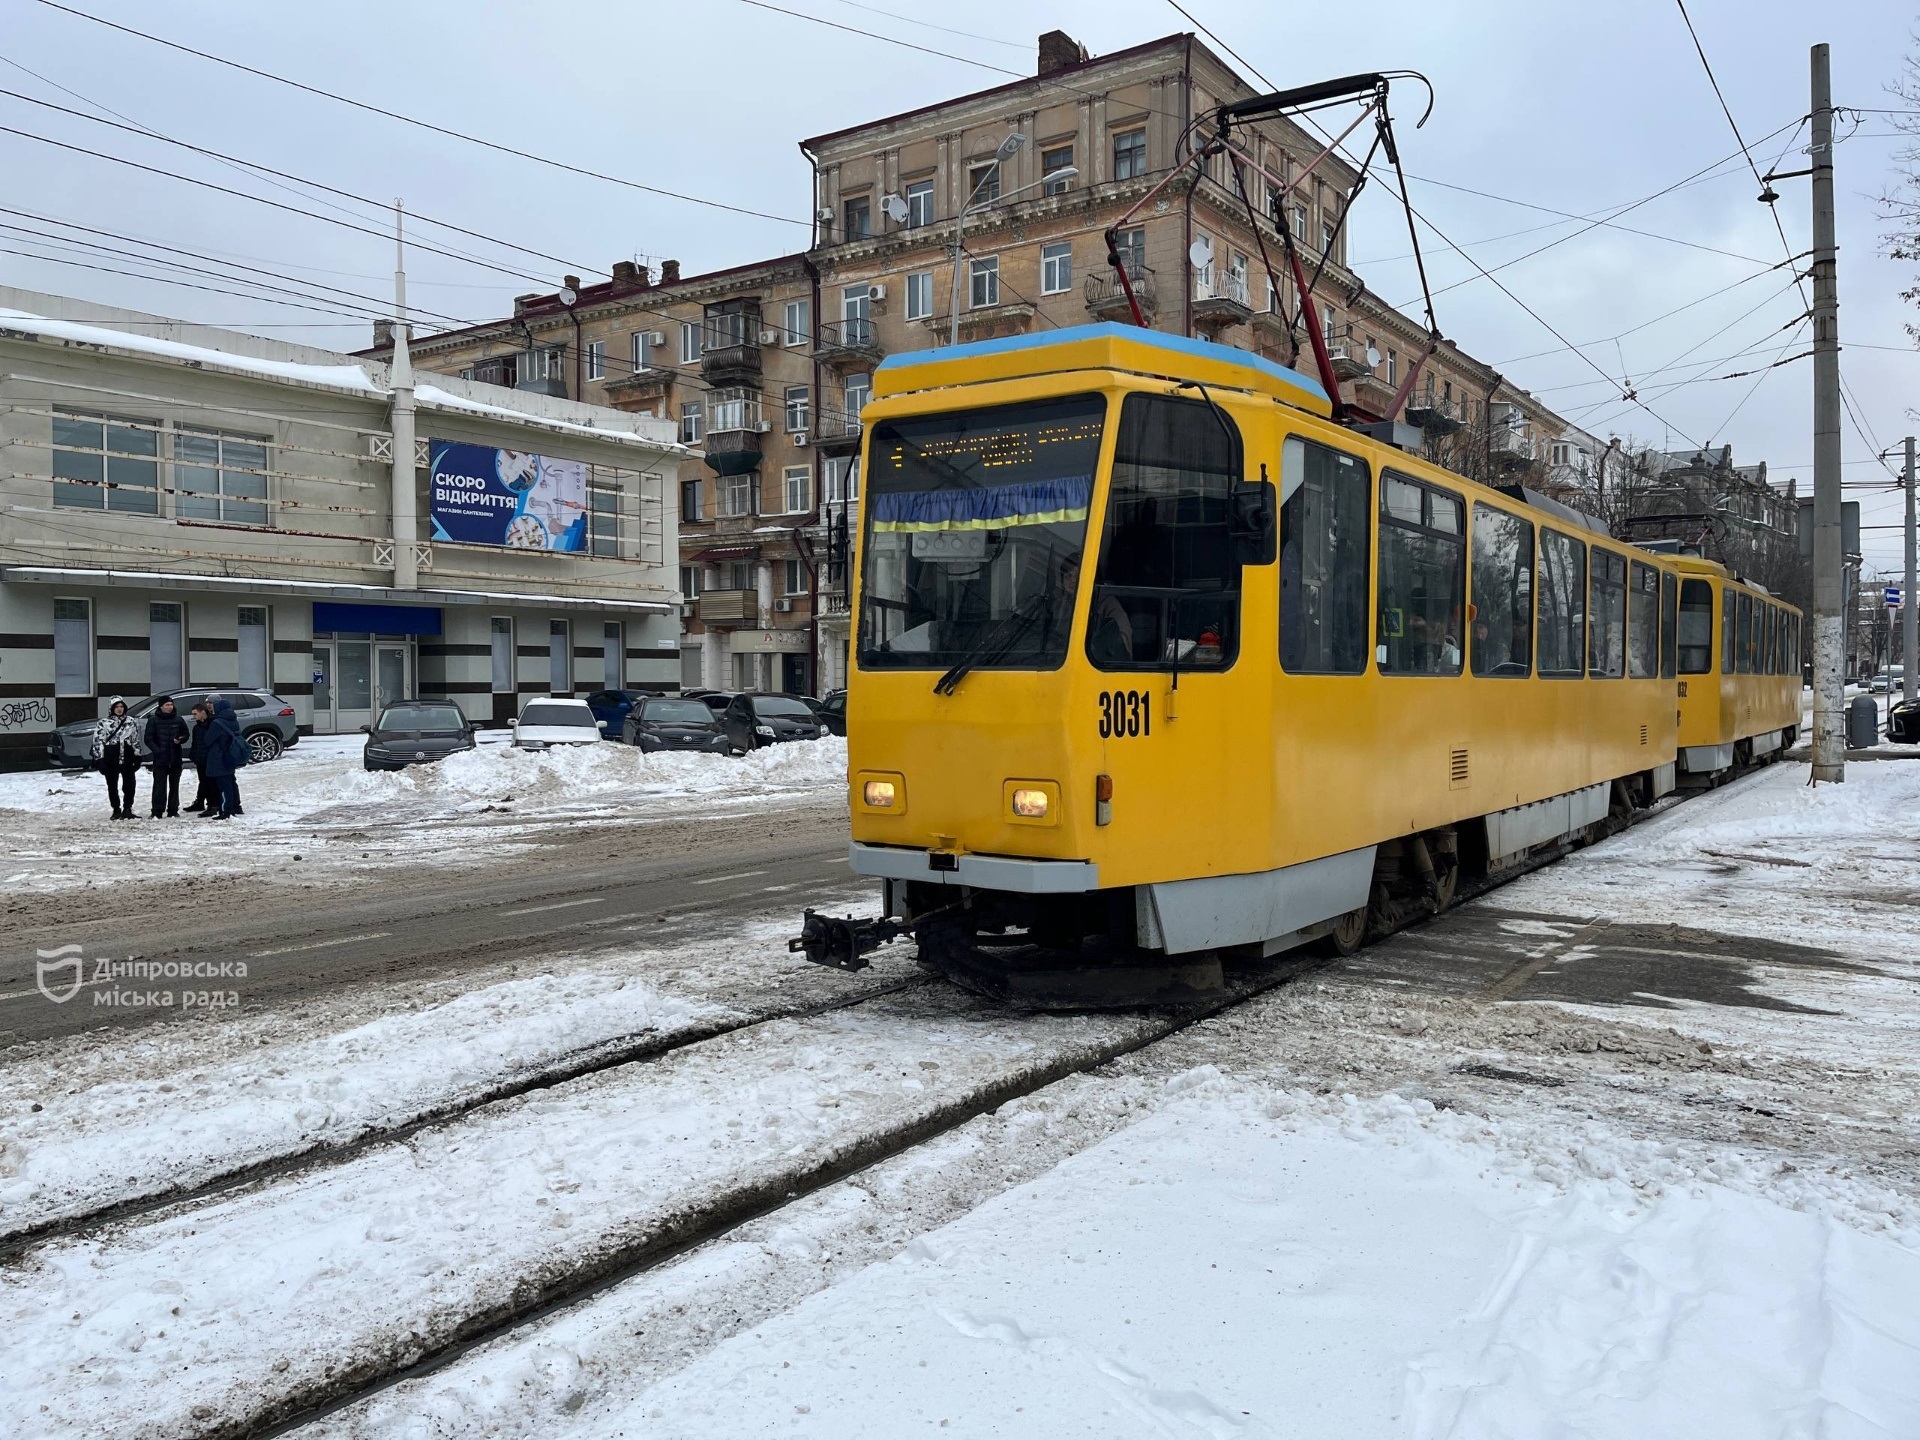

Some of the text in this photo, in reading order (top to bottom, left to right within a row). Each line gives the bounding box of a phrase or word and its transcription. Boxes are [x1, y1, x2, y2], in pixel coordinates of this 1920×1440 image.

[436, 472, 486, 490] СКОРО
[436, 488, 518, 509] ВІДКРИТТЯ!
[1678, 682, 1687, 698] 032
[1098, 690, 1150, 739] 3031
